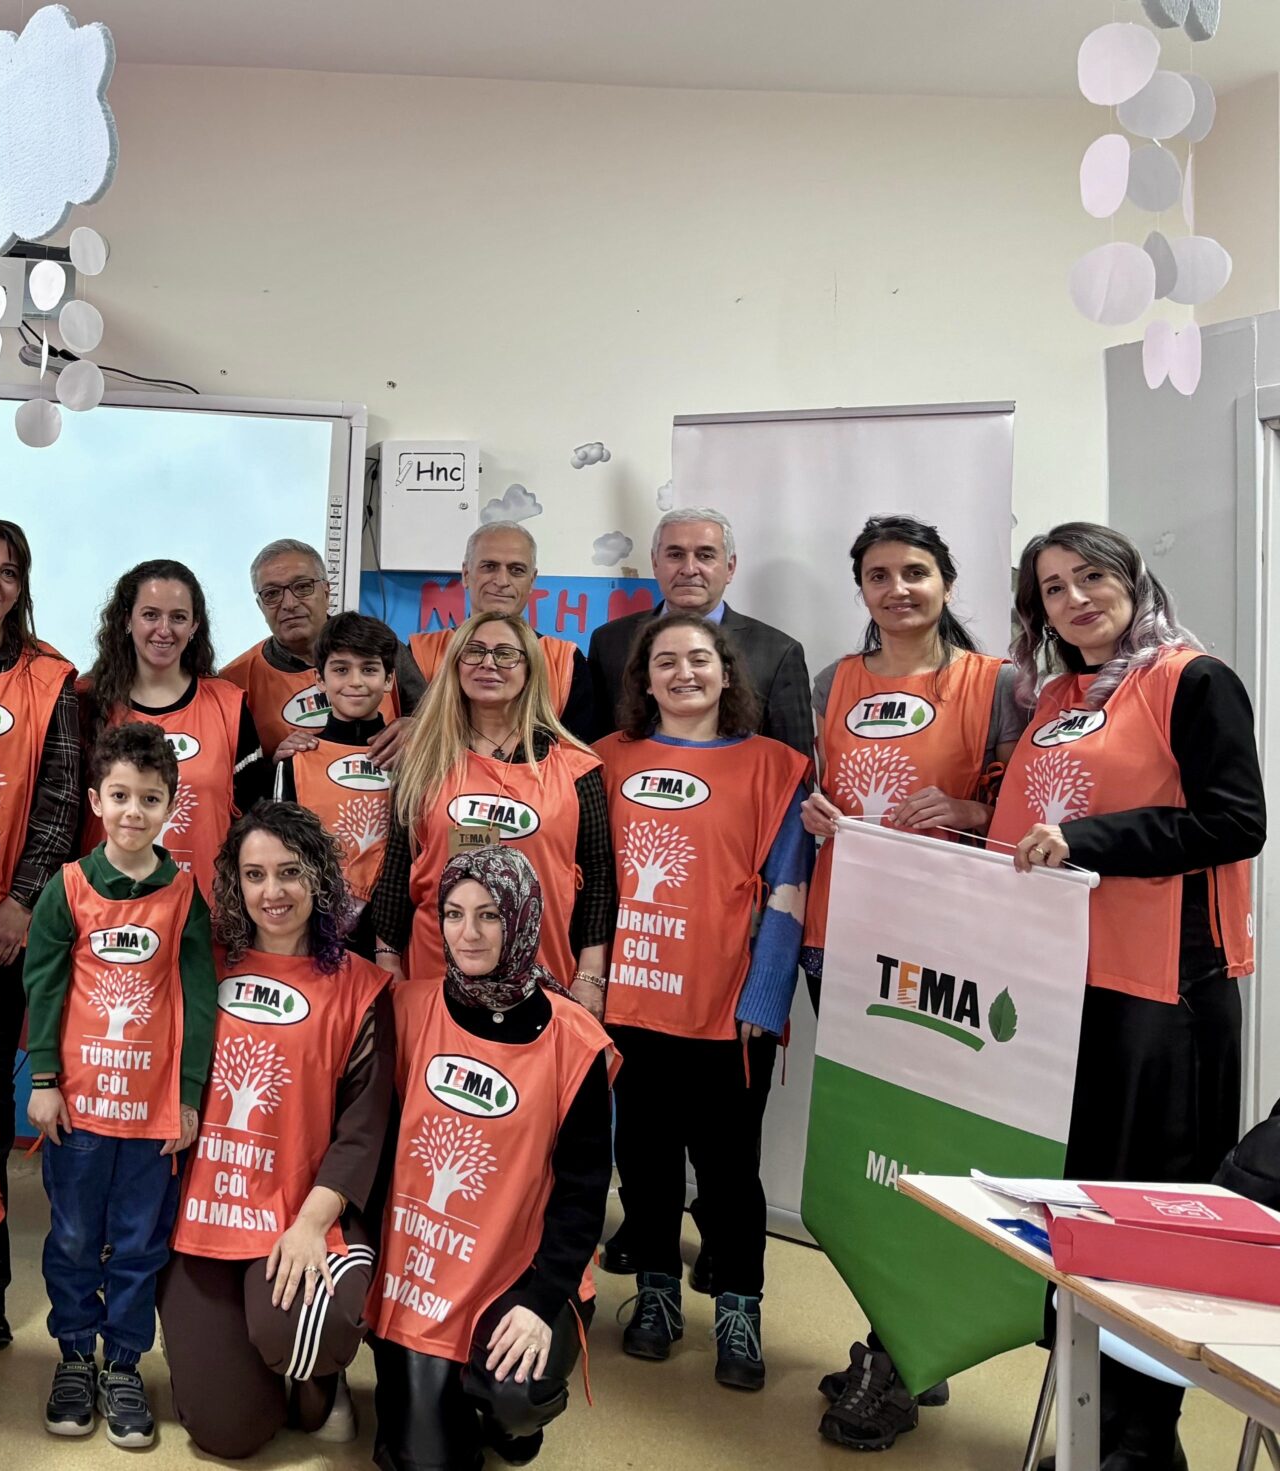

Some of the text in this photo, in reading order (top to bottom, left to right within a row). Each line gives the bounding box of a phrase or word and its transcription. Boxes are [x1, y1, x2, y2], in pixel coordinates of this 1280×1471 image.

[416, 460, 462, 482] Hnc
[421, 580, 588, 633] MTH
[297, 692, 332, 713] TEM
[864, 702, 906, 719] TEMA
[640, 776, 683, 795] TEMA
[468, 800, 515, 824] TEMA
[459, 834, 484, 843] TEMA
[616, 904, 687, 940] ÜRKİYE
[103, 932, 138, 947] TEMA
[623, 935, 660, 963] ÇÖL
[609, 962, 683, 995] LMASIN
[876, 953, 980, 1029] TEMA
[235, 982, 280, 1008] TEMA
[80, 1041, 152, 1071] TÜRKİYE
[97, 1070, 129, 1097] ÇÖL
[444, 1063, 492, 1100] TEMA
[75, 1094, 148, 1121] OLMASIN
[197, 1131, 275, 1173] TÜRKİYE
[214, 1168, 249, 1200] ÇÖL
[186, 1198, 278, 1232] OLMASIN
[393, 1204, 477, 1263] TÜRKİYE
[403, 1245, 436, 1285] ÇÖL
